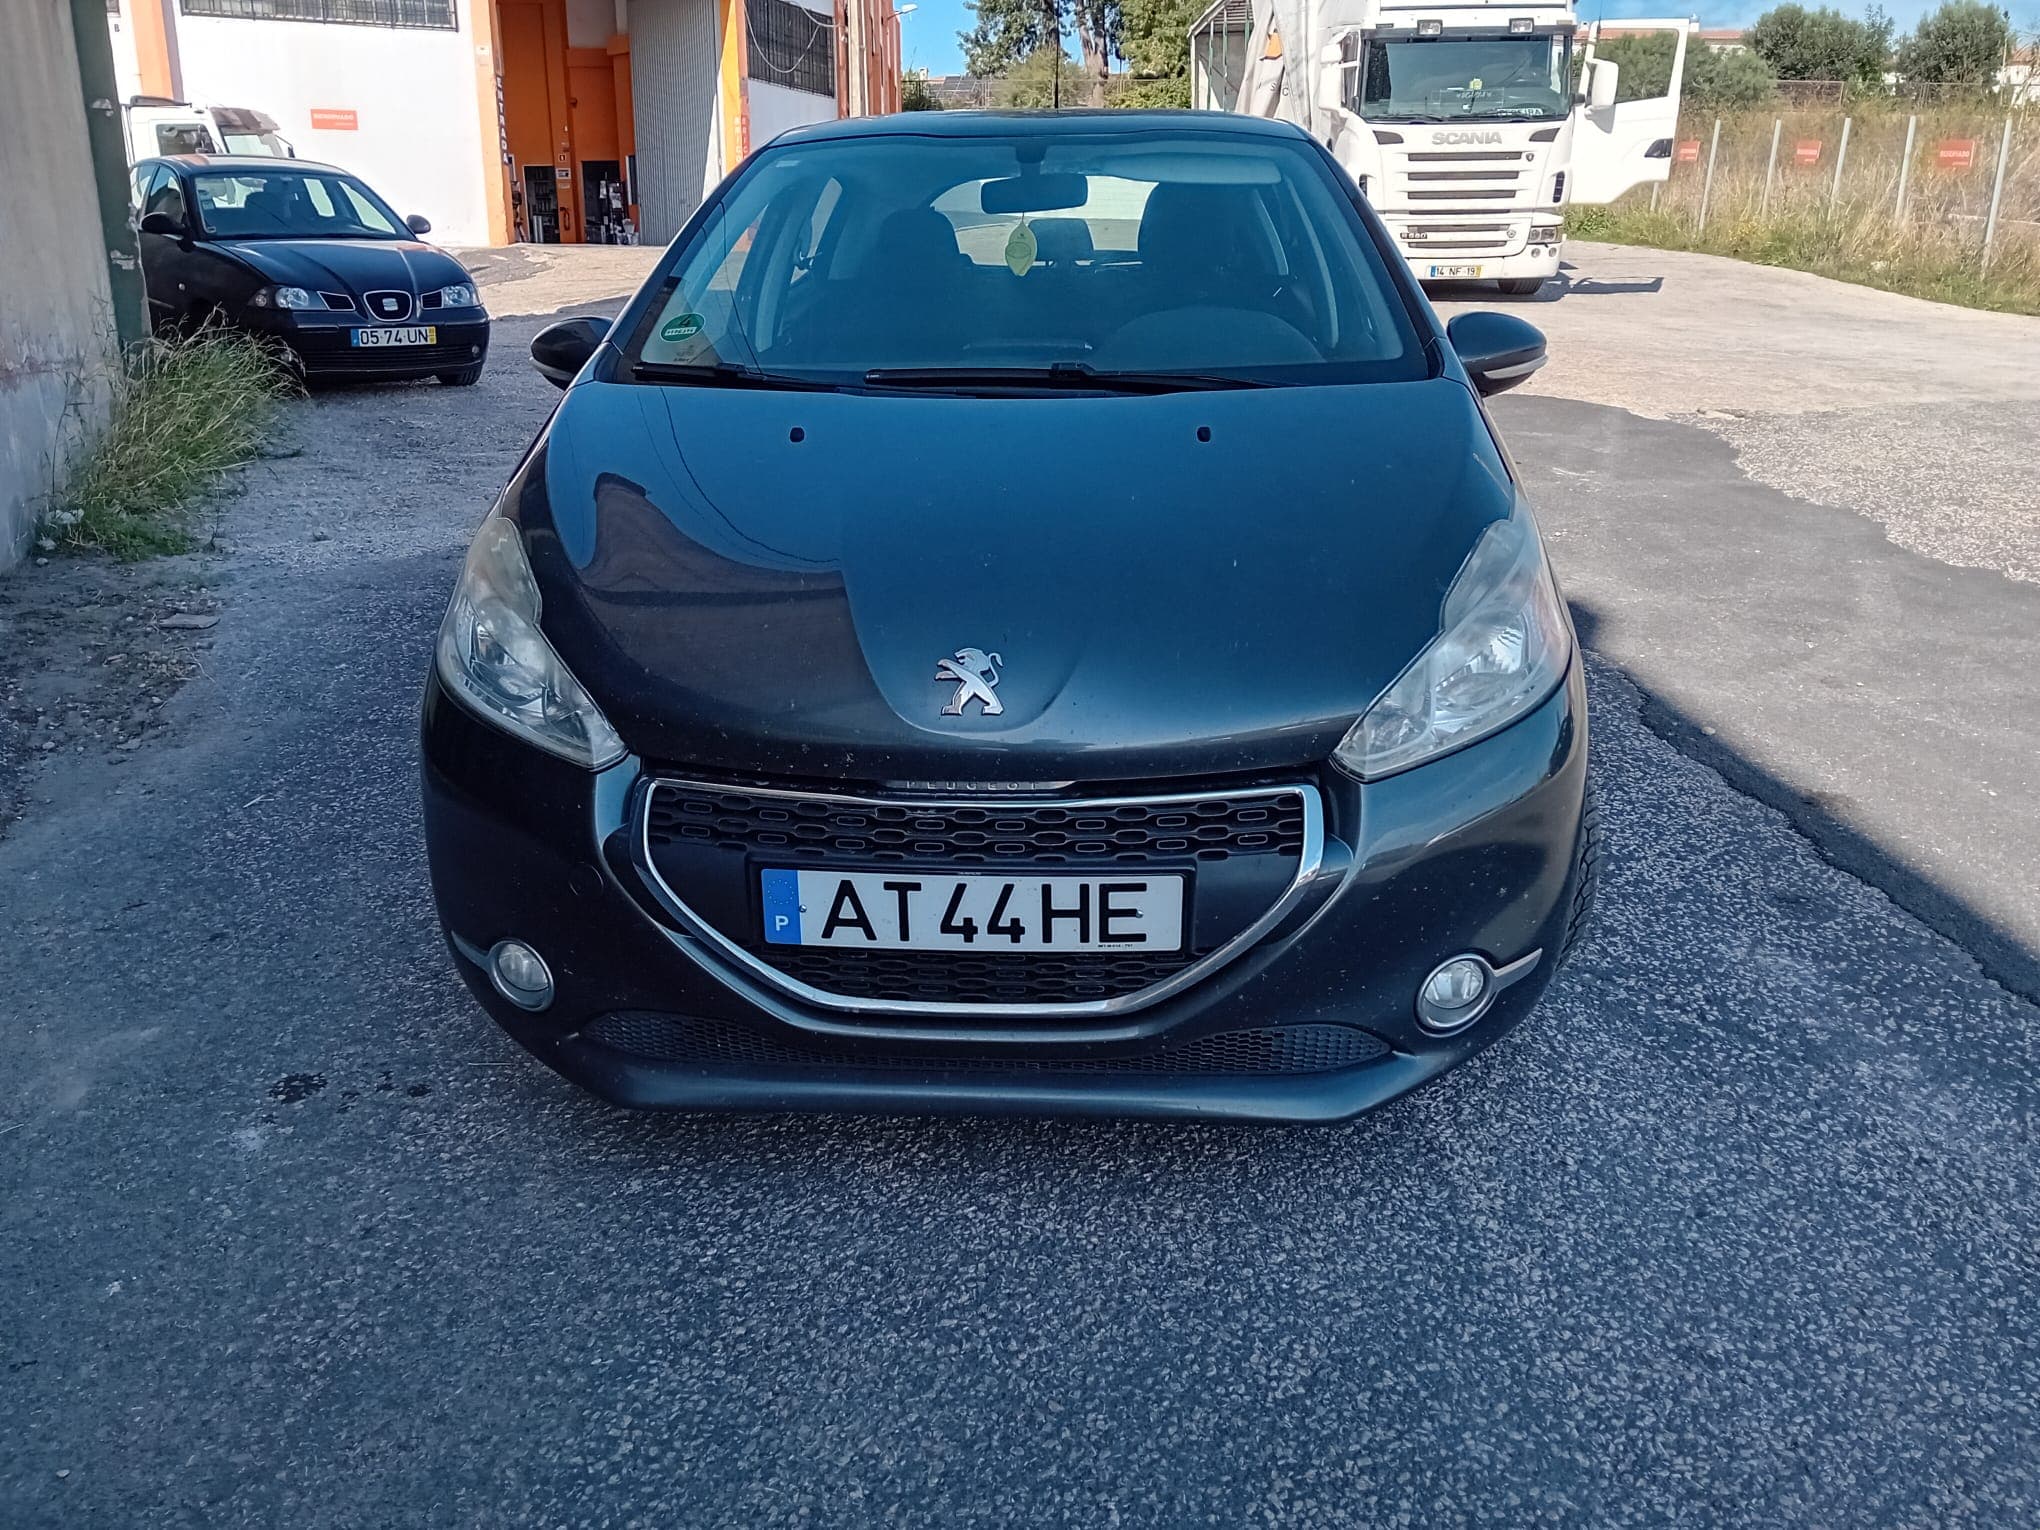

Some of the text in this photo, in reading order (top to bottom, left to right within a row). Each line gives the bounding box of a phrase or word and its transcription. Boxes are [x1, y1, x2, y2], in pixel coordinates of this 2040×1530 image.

[496, 76, 509, 164] ENTRADA
[1432, 131, 1502, 145] SCANIA
[906, 780, 1036, 790] PEUGEOT
[776, 915, 788, 931] P
